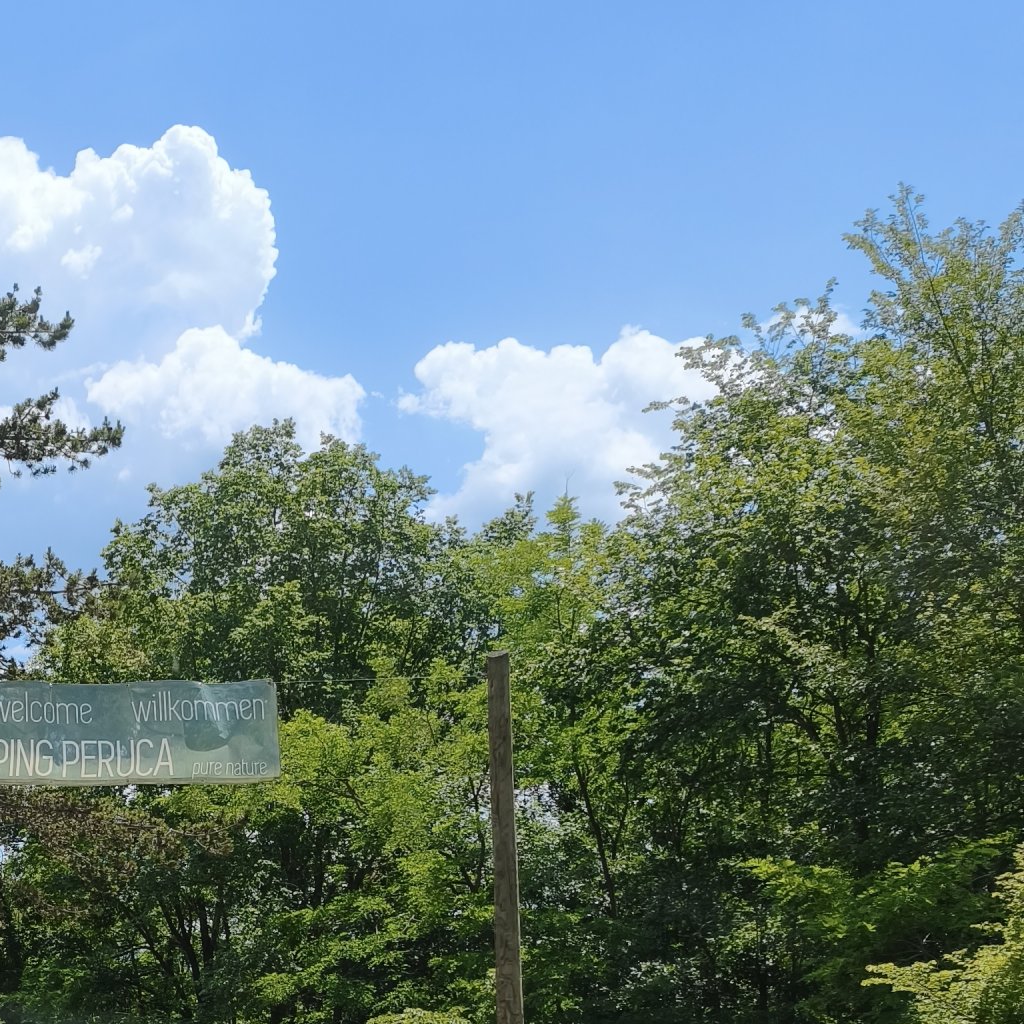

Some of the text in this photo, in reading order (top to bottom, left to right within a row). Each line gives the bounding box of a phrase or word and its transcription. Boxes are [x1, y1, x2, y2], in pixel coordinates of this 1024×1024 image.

[131, 690, 264, 722] willkommen
[62, 738, 174, 778] PERUCA
[192, 760, 268, 779] pure nature
